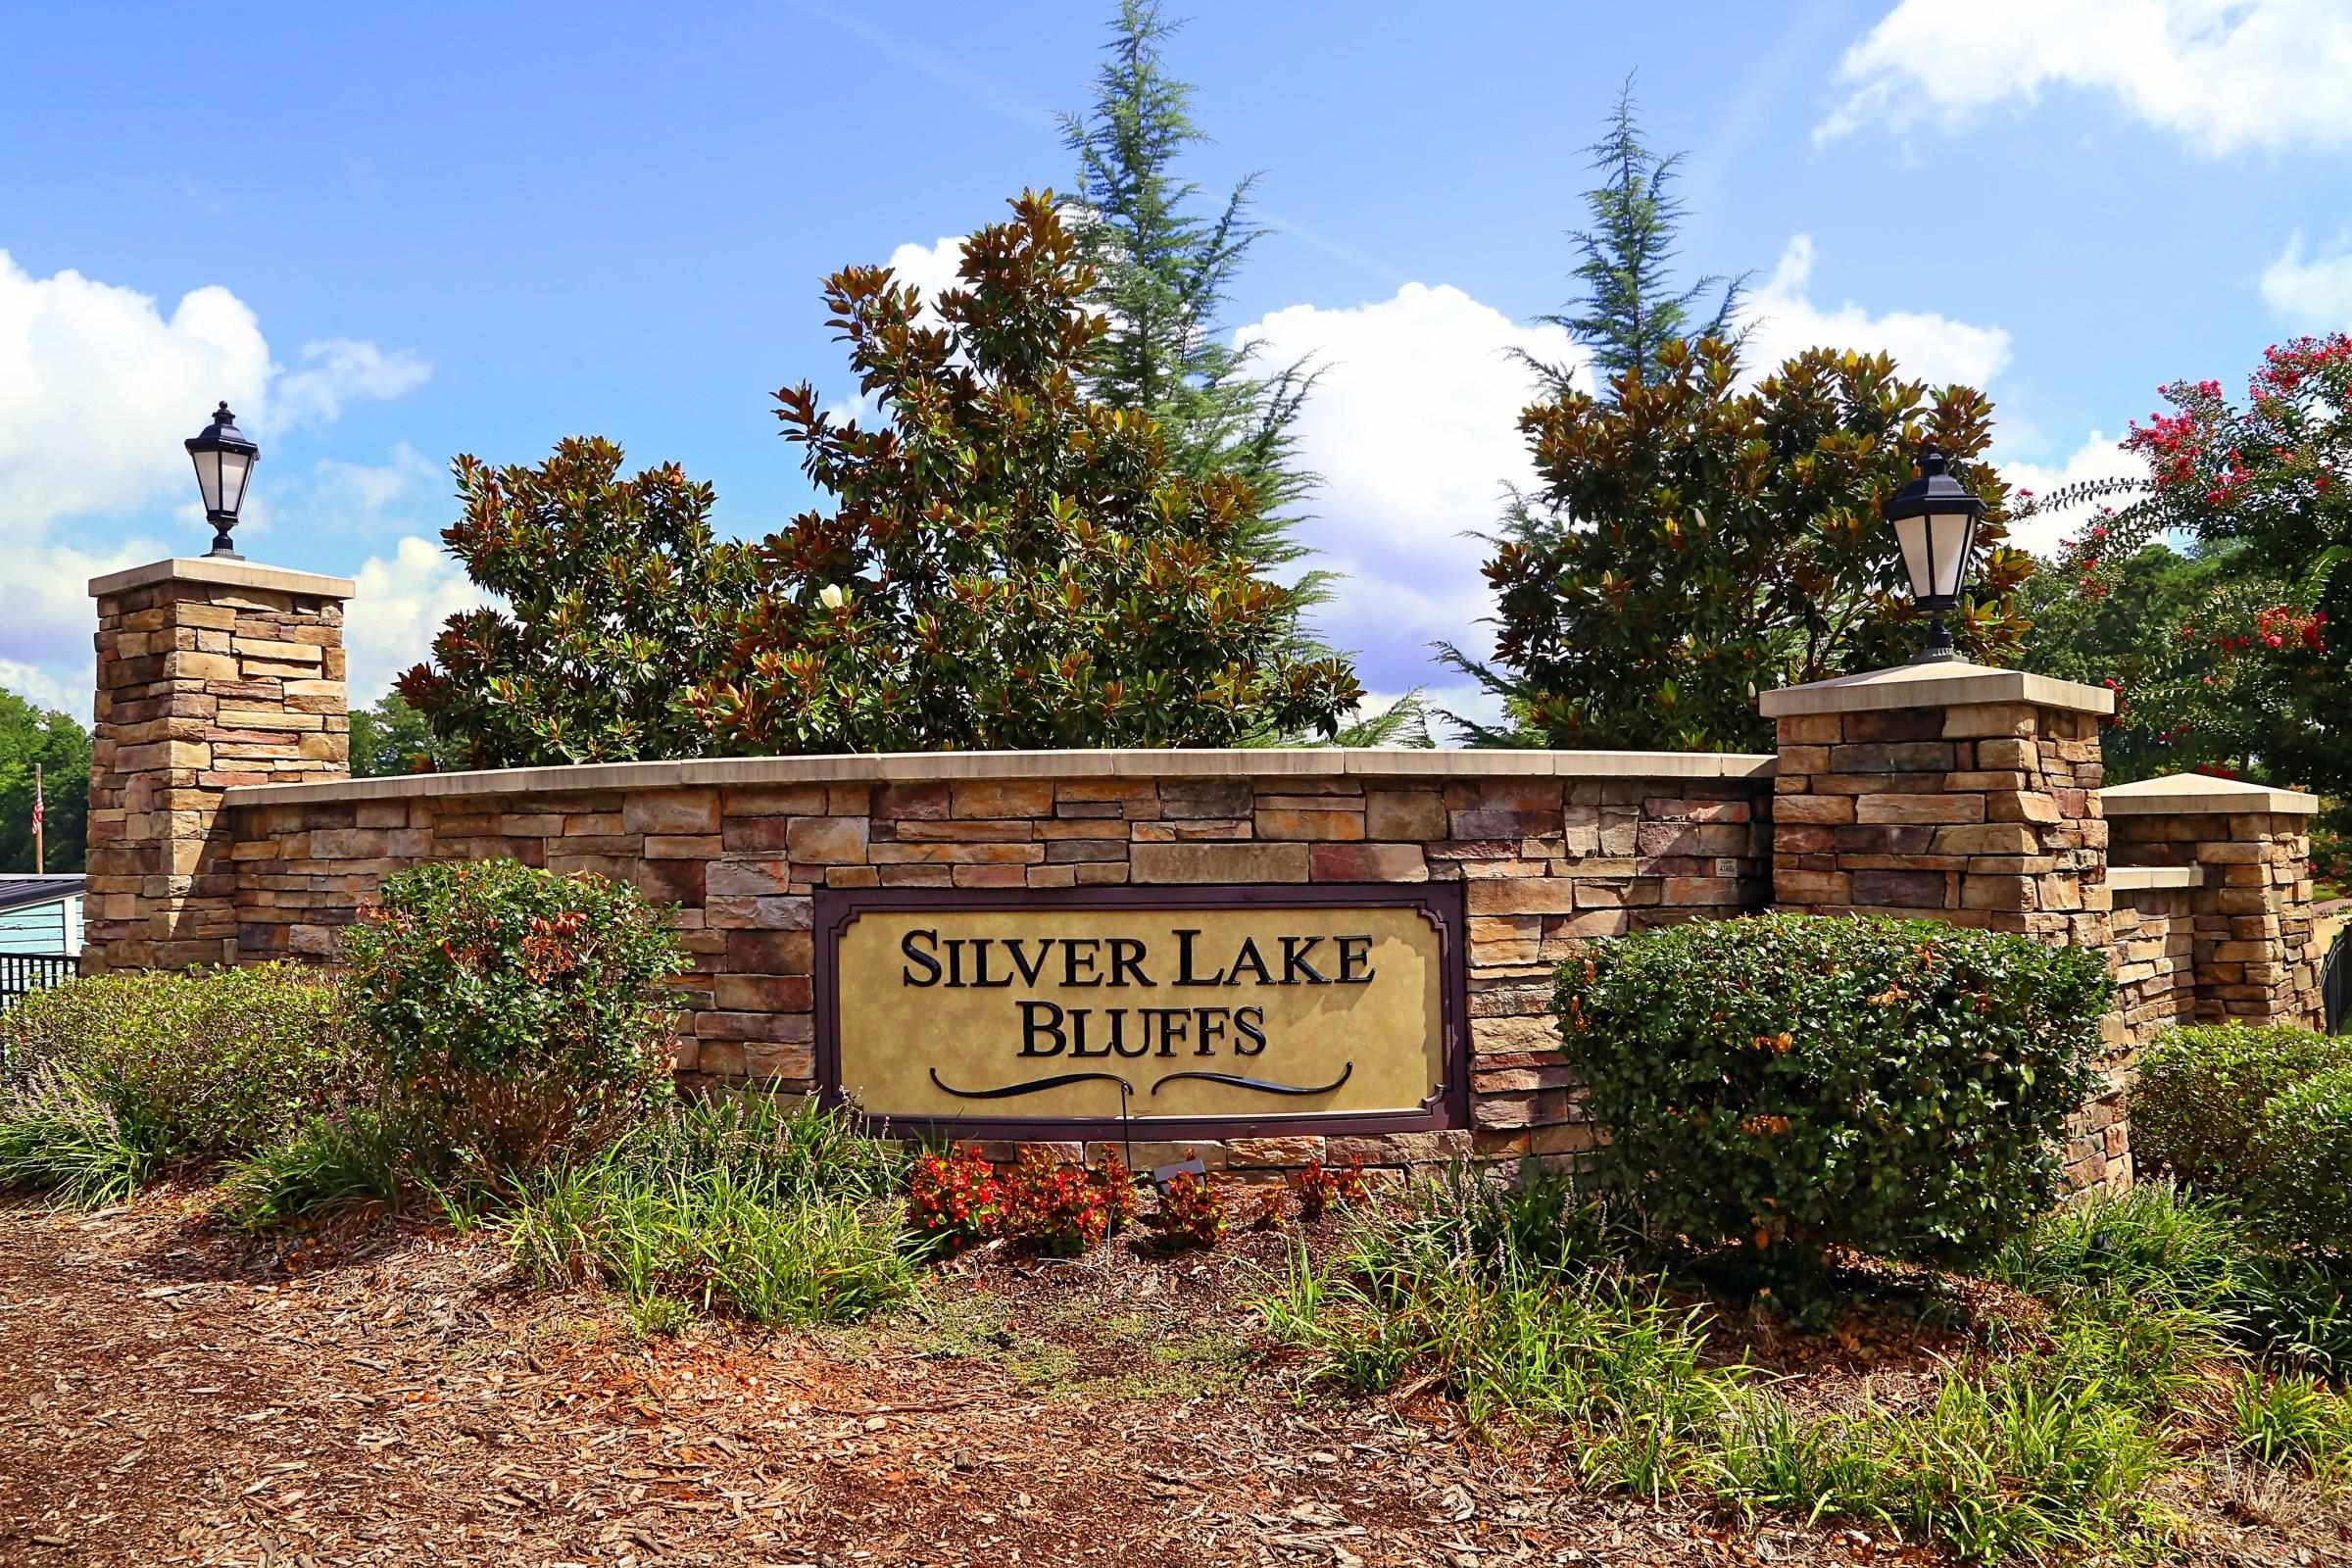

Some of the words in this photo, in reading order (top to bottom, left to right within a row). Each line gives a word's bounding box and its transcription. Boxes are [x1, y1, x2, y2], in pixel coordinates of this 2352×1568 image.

[902, 929, 1157, 988] SILVER
[1171, 929, 1375, 986] LAKE
[1016, 1000, 1267, 1057] BLUFFS
